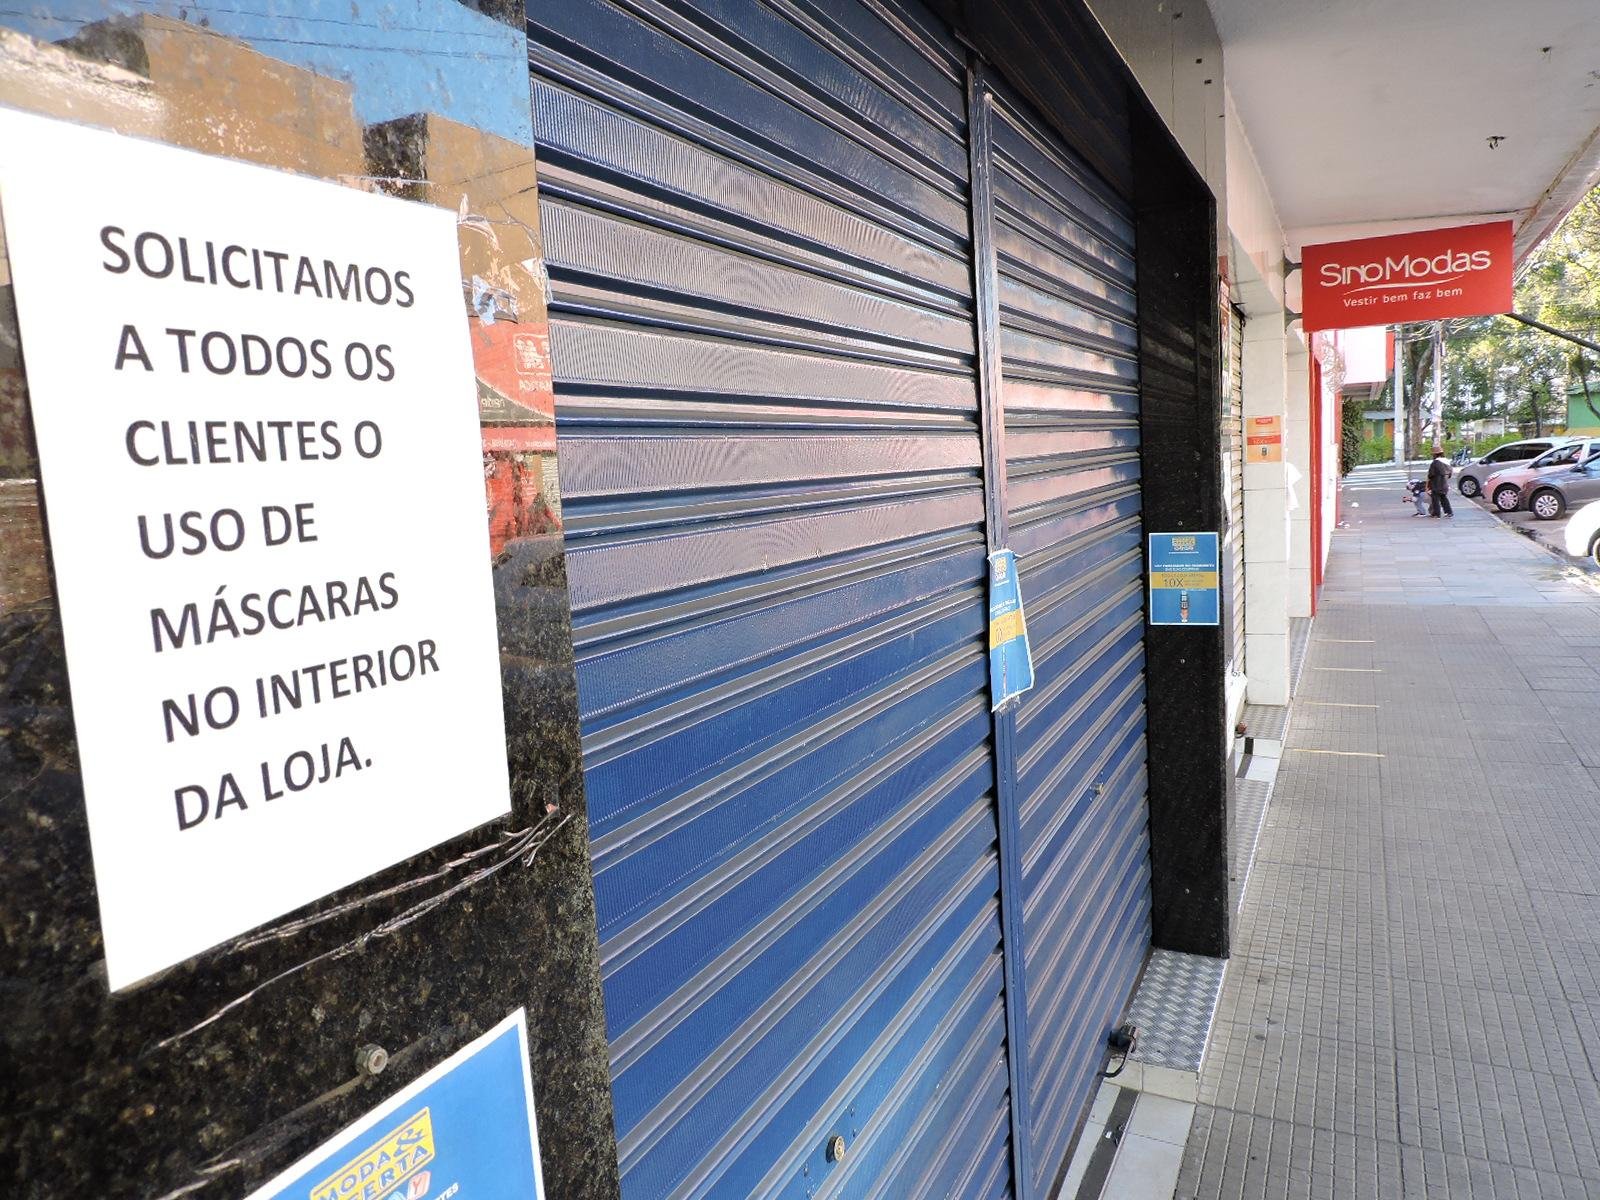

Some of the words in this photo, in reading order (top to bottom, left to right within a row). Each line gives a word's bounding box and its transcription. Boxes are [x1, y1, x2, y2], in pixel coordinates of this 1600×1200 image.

[101, 226, 414, 308] SOLICITAMOS
[1320, 249, 1492, 287] SinoModas
[1343, 296, 1378, 308] Vestir
[1383, 294, 1408, 304] bem
[1413, 290, 1432, 301] faz
[1436, 287, 1463, 298] bem
[116, 325, 153, 371] A
[166, 329, 332, 379] TODOS
[344, 342, 395, 382] OS
[126, 420, 342, 466] CLIENTES
[354, 420, 382, 459] O
[138, 508, 245, 560] USO
[261, 503, 318, 547] DE
[151, 573, 399, 653] MÁSCARAS
[163, 686, 240, 743] NO
[256, 639, 440, 718] INTERIOR
[175, 773, 248, 831] DA
[261, 736, 374, 802] LOJA.
